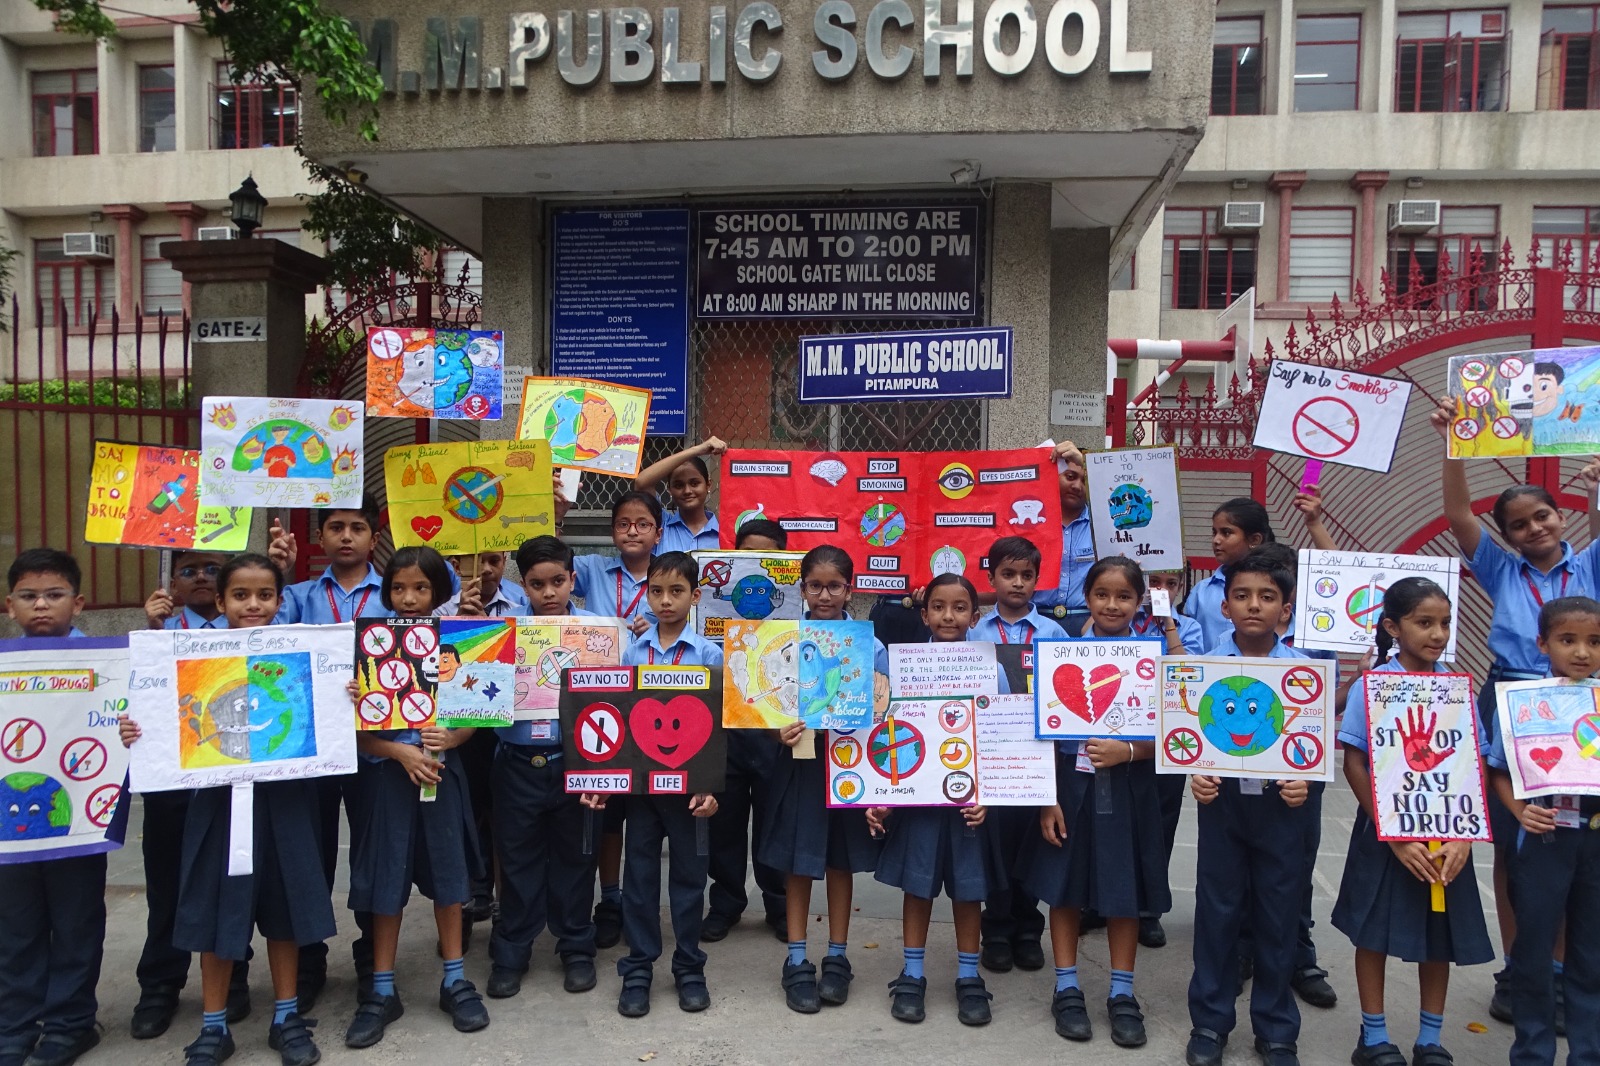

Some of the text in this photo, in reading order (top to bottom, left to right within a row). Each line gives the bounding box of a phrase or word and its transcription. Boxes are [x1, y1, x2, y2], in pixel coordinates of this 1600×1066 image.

[509, 2, 783, 87] PUBLIC
[812, 0, 1153, 79] SCHOOL
[715, 211, 961, 232] SCHOOL TIMMING ARE
[705, 238, 759, 259] 7:45
[768, 237, 808, 259] AM
[818, 236, 854, 258] TO
[864, 235, 921, 257] 2:00
[931, 235, 970, 256] PM
[737, 263, 936, 283] SCHOOL GATE WILL CLOSE
[703, 292, 970, 312] AT 8:00 AM SHARP IN THE MORNING
[607, 316, 633, 324] DON'TS
[197, 321, 262, 338] GATE-2
[806, 338, 1004, 377] M.M. PUBLIC SCHOOL
[1272, 362, 1300, 389] Say
[1303, 371, 1316, 385] no
[1318, 370, 1331, 388] to
[865, 377, 939, 391] PITAMPURA
[269, 399, 301, 408] SMOKE
[98, 446, 124, 462] SAY
[1093, 452, 1173, 465] LIFE IS TO SHORT
[734, 464, 785, 473] BRAIN STROKE
[871, 462, 895, 471] STOP
[1121, 463, 1133, 471] TO
[981, 470, 1033, 481] EYES DISEASES
[1114, 474, 1138, 483] SMOKE
[861, 480, 904, 490] SMOKING
[96, 487, 120, 500] TO
[88, 502, 137, 521] DRUGS
[937, 515, 992, 525] YELLOW TEETH
[871, 558, 896, 570] QUIT
[857, 578, 905, 589] TOBACCO
[173, 629, 299, 655] BREATHE EASY
[1054, 646, 1141, 658] SAY NO TO SMOKE
[10, 676, 89, 691] NO TO DRUGS
[129, 670, 168, 690] LIVE
[572, 673, 629, 685] SAY NO TO
[643, 673, 704, 685] SMOKING
[1369, 679, 1426, 692] International
[1165, 689, 1197, 697] NO TO
[103, 698, 128, 712] NO
[1303, 708, 1323, 716] STOP
[88, 710, 119, 728] DRIN
[1302, 725, 1322, 733] STOP
[568, 777, 629, 789] SAY YES TO
[656, 777, 680, 788] LIFE
[1402, 771, 1450, 792] SAY
[1393, 793, 1473, 815] NO TO
[1398, 813, 1480, 835] DRUGS
